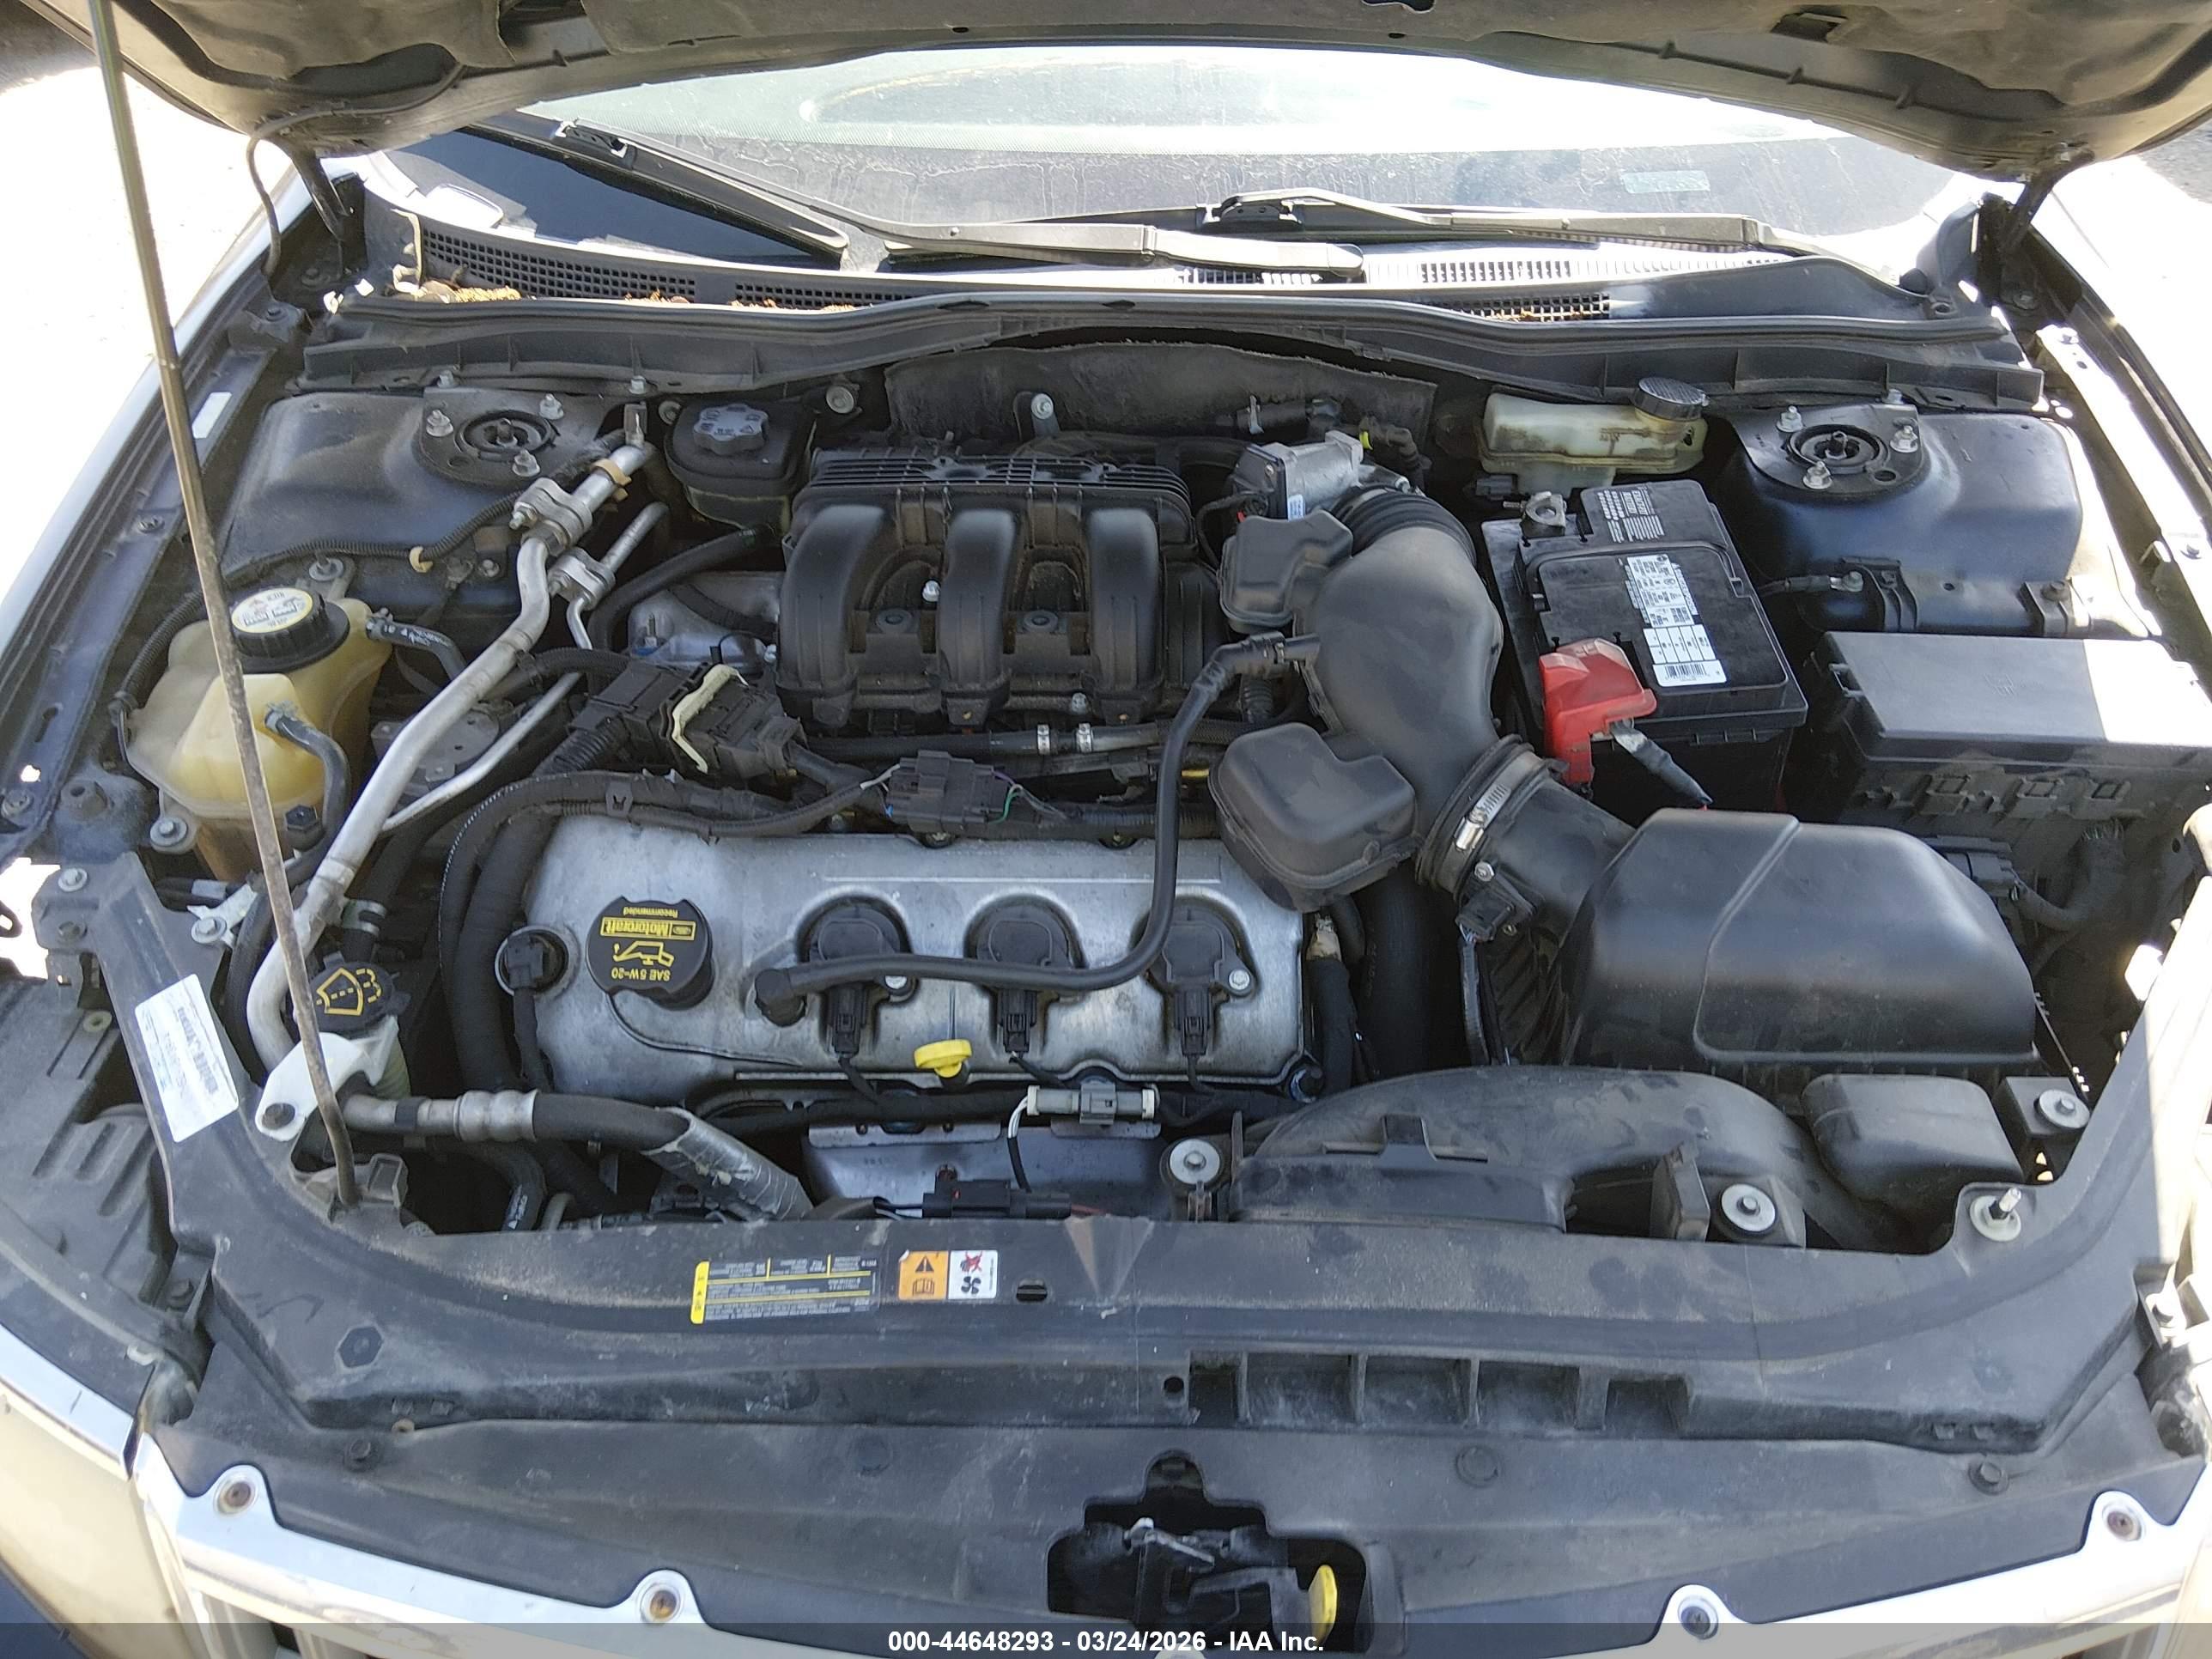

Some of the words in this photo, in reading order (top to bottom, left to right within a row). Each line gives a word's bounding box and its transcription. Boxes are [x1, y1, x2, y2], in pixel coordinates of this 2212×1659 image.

[623, 906, 678, 918] Recommended
[605, 920, 669, 937] Motorcraft
[649, 969, 671, 981] SAE
